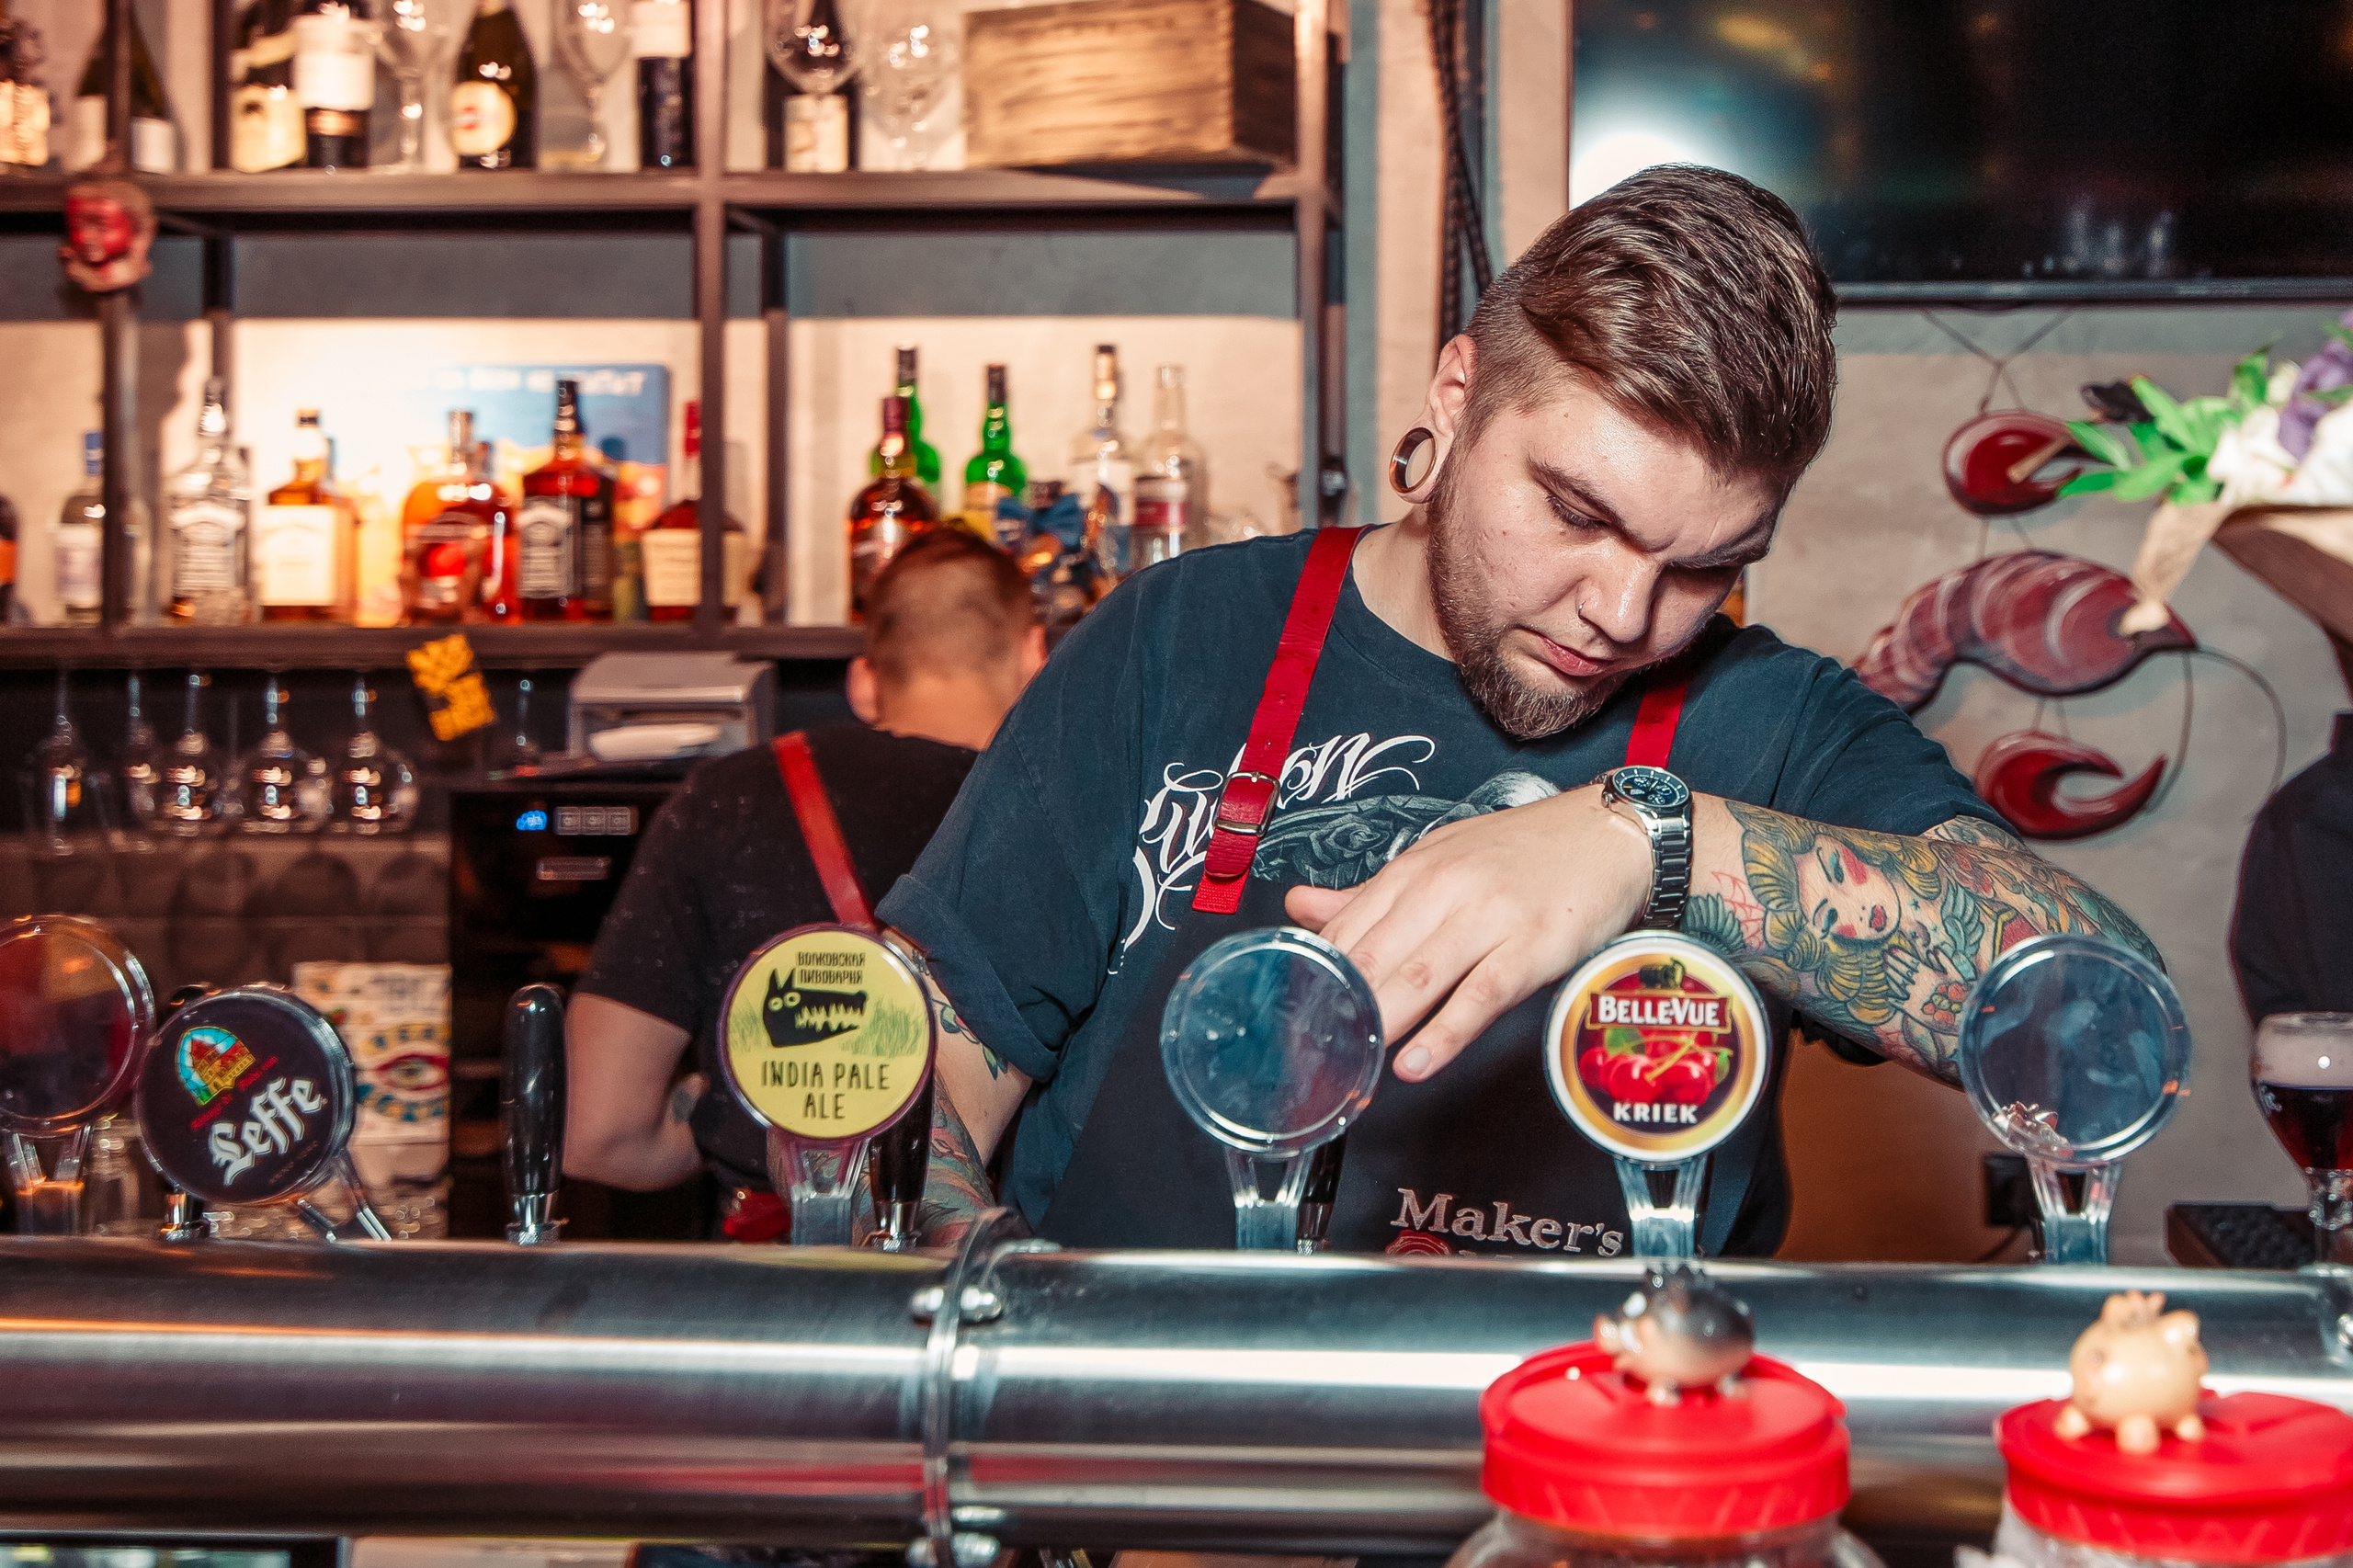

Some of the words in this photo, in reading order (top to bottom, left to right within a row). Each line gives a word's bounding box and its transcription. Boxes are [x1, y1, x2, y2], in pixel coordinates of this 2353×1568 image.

[798, 952, 866, 967] ВОЛКОВСКАЯ
[801, 969, 863, 984] ПИВОВАРНЯ
[762, 1060, 824, 1087] INDIA
[834, 1062, 891, 1090] PALE
[803, 1092, 847, 1119] ALE
[1613, 1102, 1699, 1124] KRIEK
[209, 1077, 323, 1187] Leffe
[1390, 1187, 1624, 1257] Maker's
